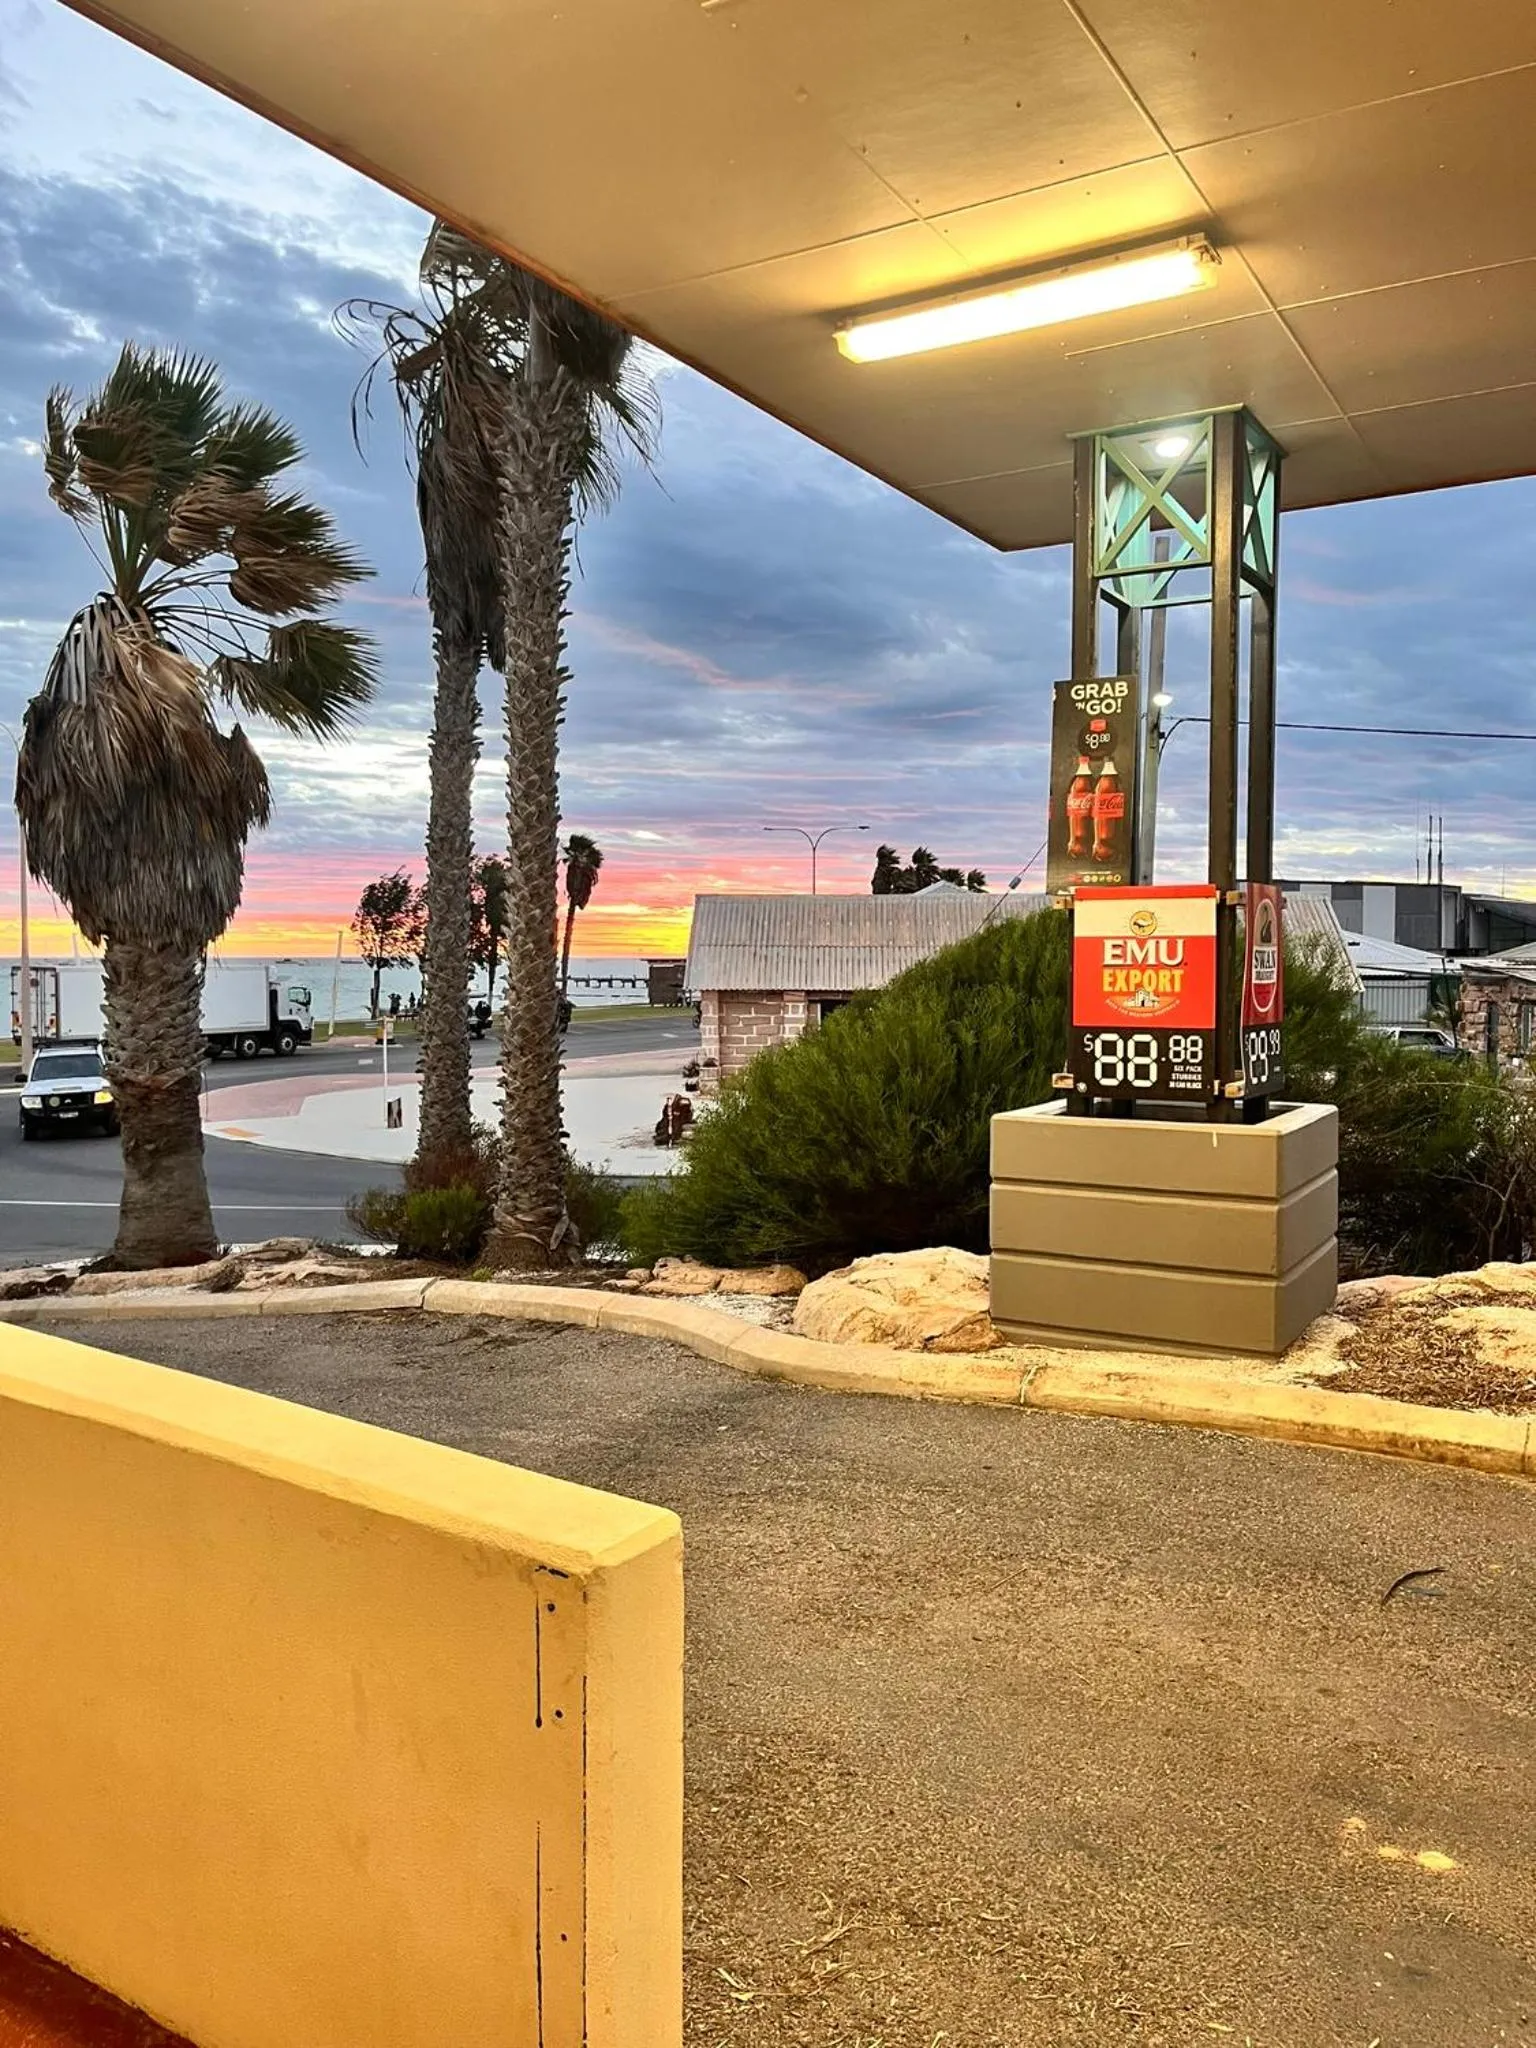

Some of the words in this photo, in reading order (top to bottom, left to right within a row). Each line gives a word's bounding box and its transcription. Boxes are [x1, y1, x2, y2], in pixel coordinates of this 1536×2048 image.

[1070, 681, 1129, 700] GRAB
[1086, 698, 1122, 715] GO!
[1102, 939, 1185, 966] EMU
[1254, 949, 1276, 969] SWAN
[1102, 969, 1185, 992] EXPORT
